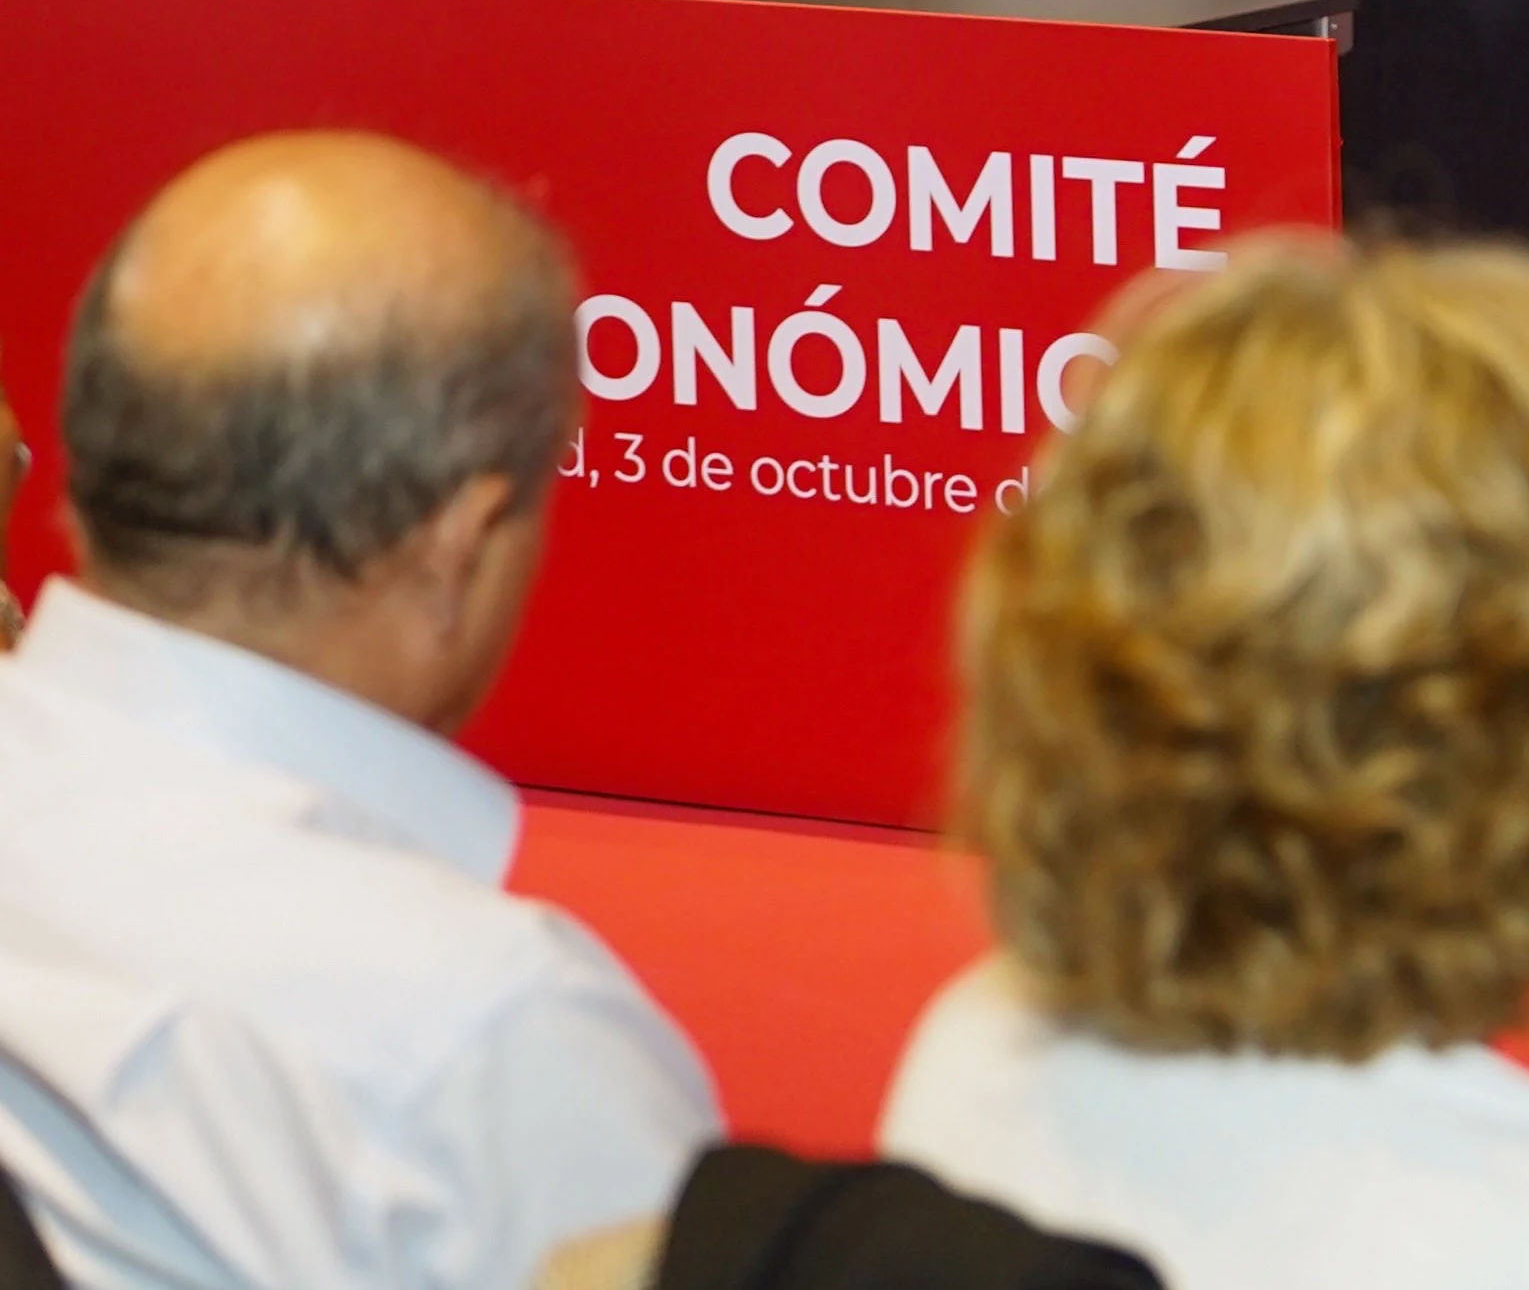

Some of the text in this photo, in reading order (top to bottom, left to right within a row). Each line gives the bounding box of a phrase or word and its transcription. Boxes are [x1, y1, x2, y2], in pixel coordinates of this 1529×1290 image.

[706, 131, 1228, 270] COMITÉ
[572, 283, 1121, 435] ONÓMIC
[613, 432, 646, 483] 3
[662, 436, 734, 491] de
[750, 454, 977, 513] octubre
[994, 466, 1030, 516] d
